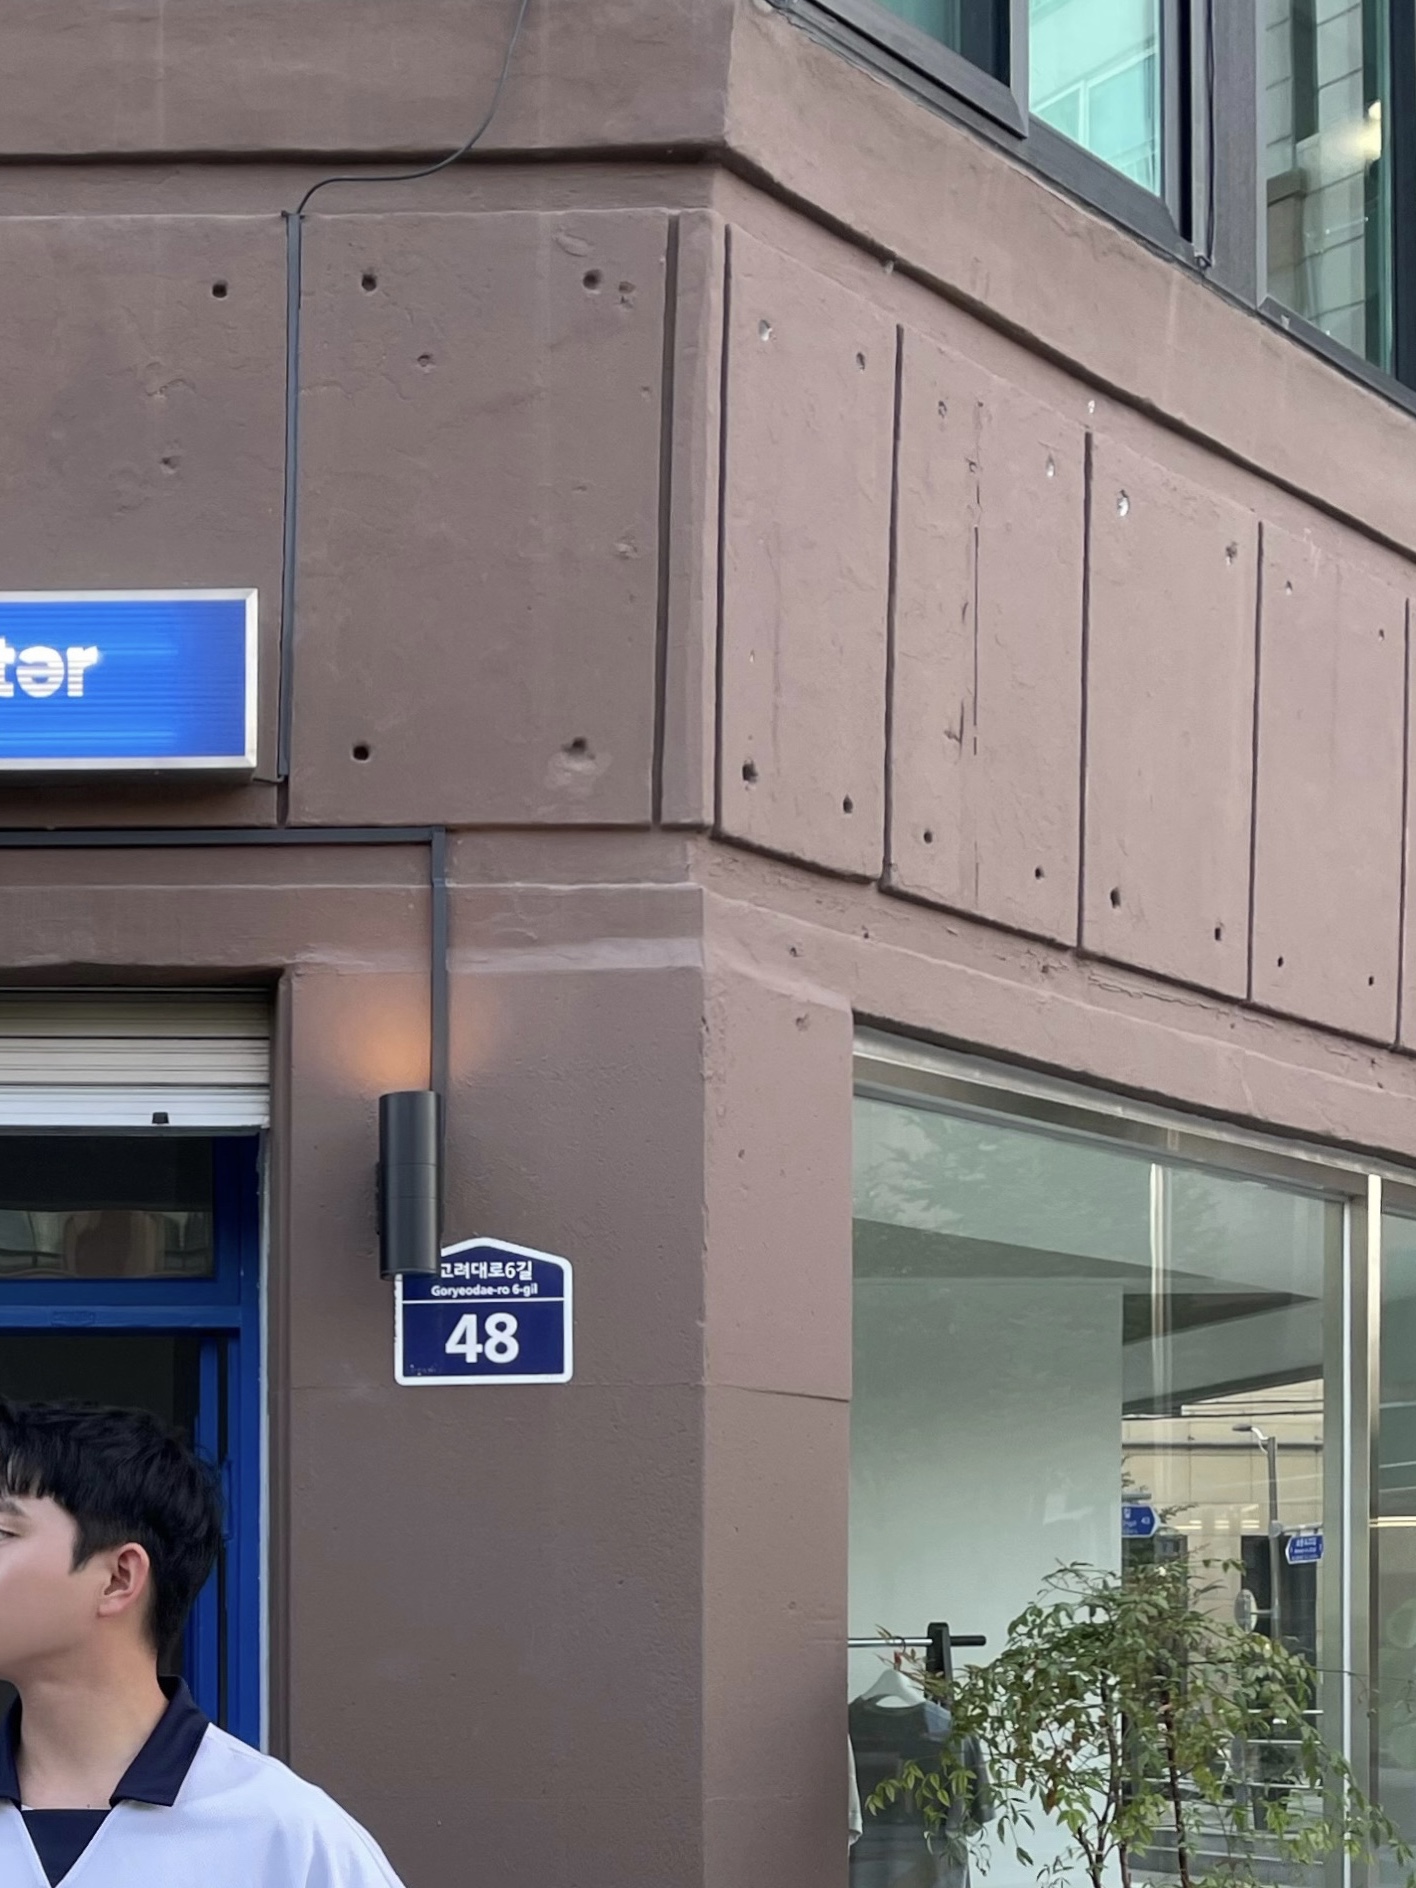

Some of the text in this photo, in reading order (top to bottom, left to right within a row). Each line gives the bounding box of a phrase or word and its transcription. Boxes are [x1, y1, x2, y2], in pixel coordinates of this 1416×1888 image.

[440, 1260, 533, 1281] 고려대로6길
[430, 1282, 539, 1299] Goryeodae-ro 6-gil
[444, 1311, 520, 1364] 48
